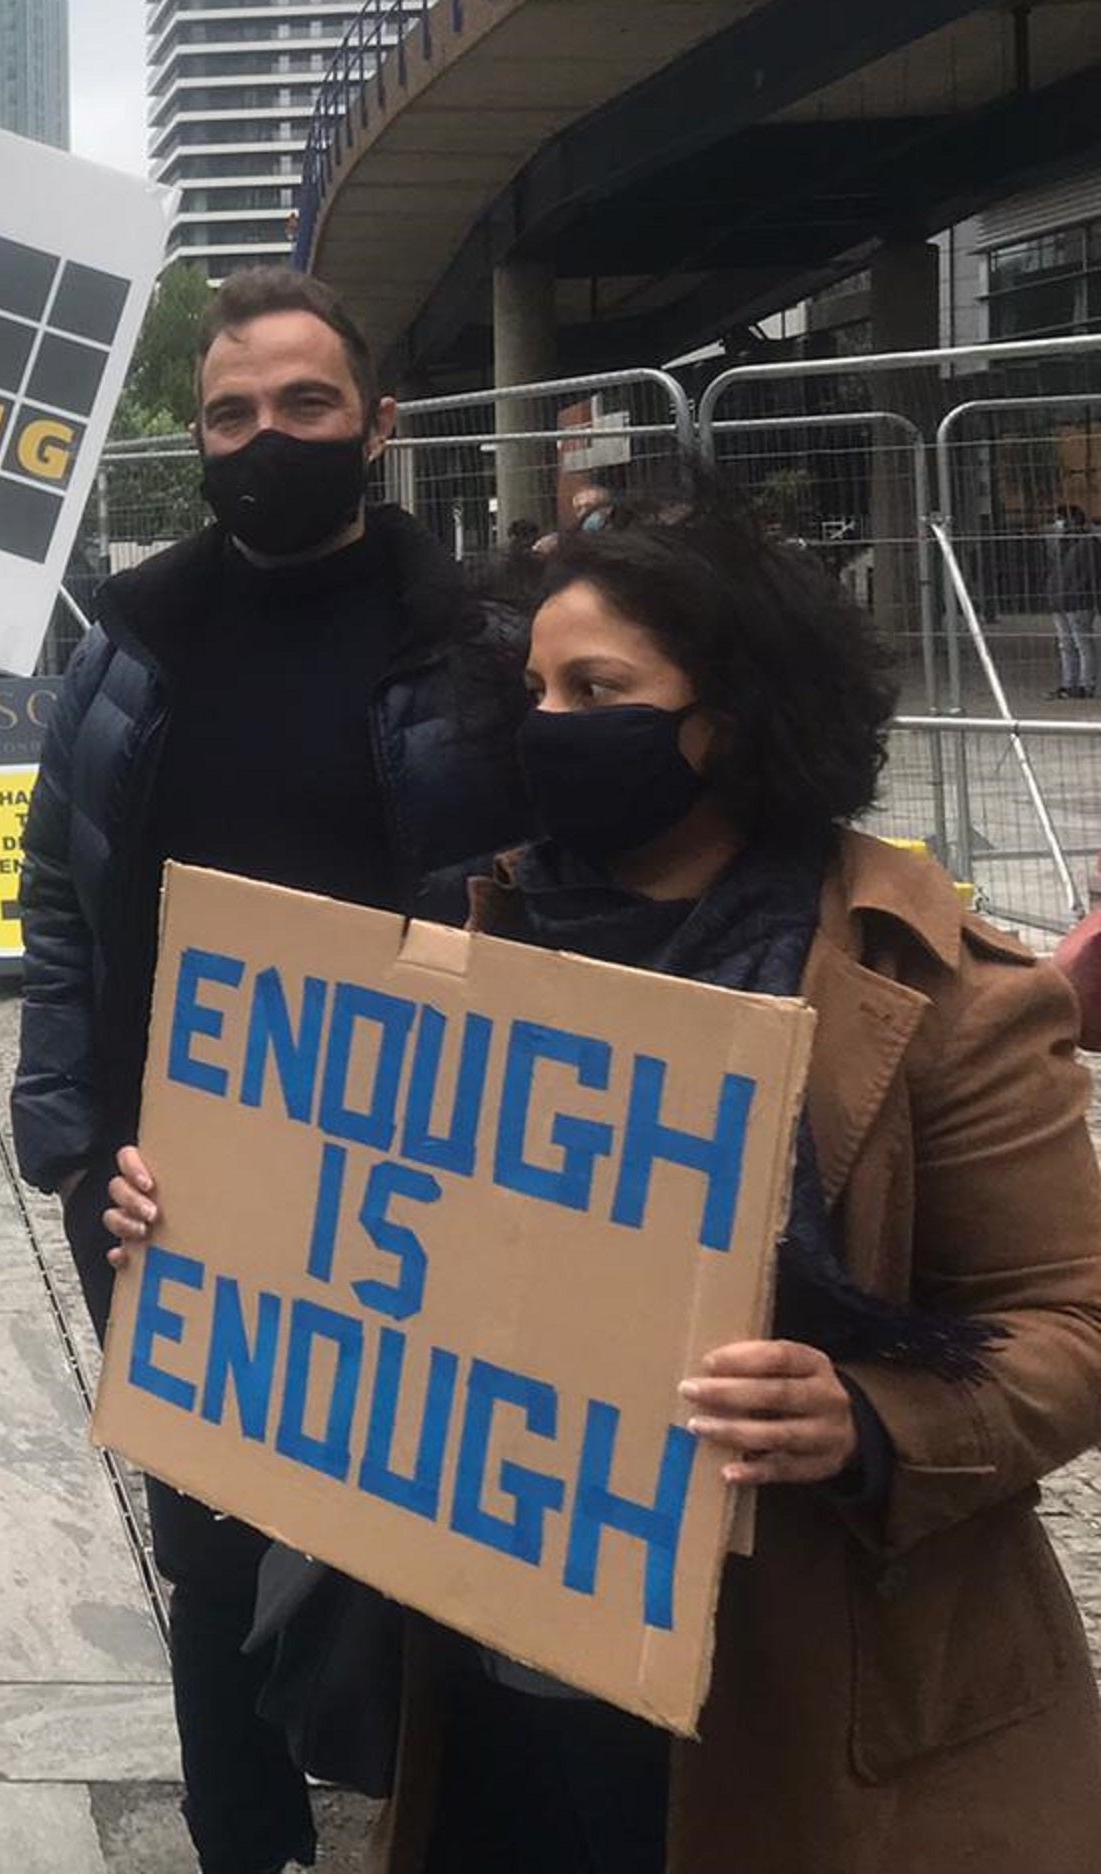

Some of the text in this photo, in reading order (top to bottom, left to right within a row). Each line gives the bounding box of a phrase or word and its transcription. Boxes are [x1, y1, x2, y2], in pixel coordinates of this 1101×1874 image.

[167, 947, 756, 1252] ENOUGH
[307, 1143, 442, 1321] IS
[128, 1246, 698, 1631] ENOUGH
